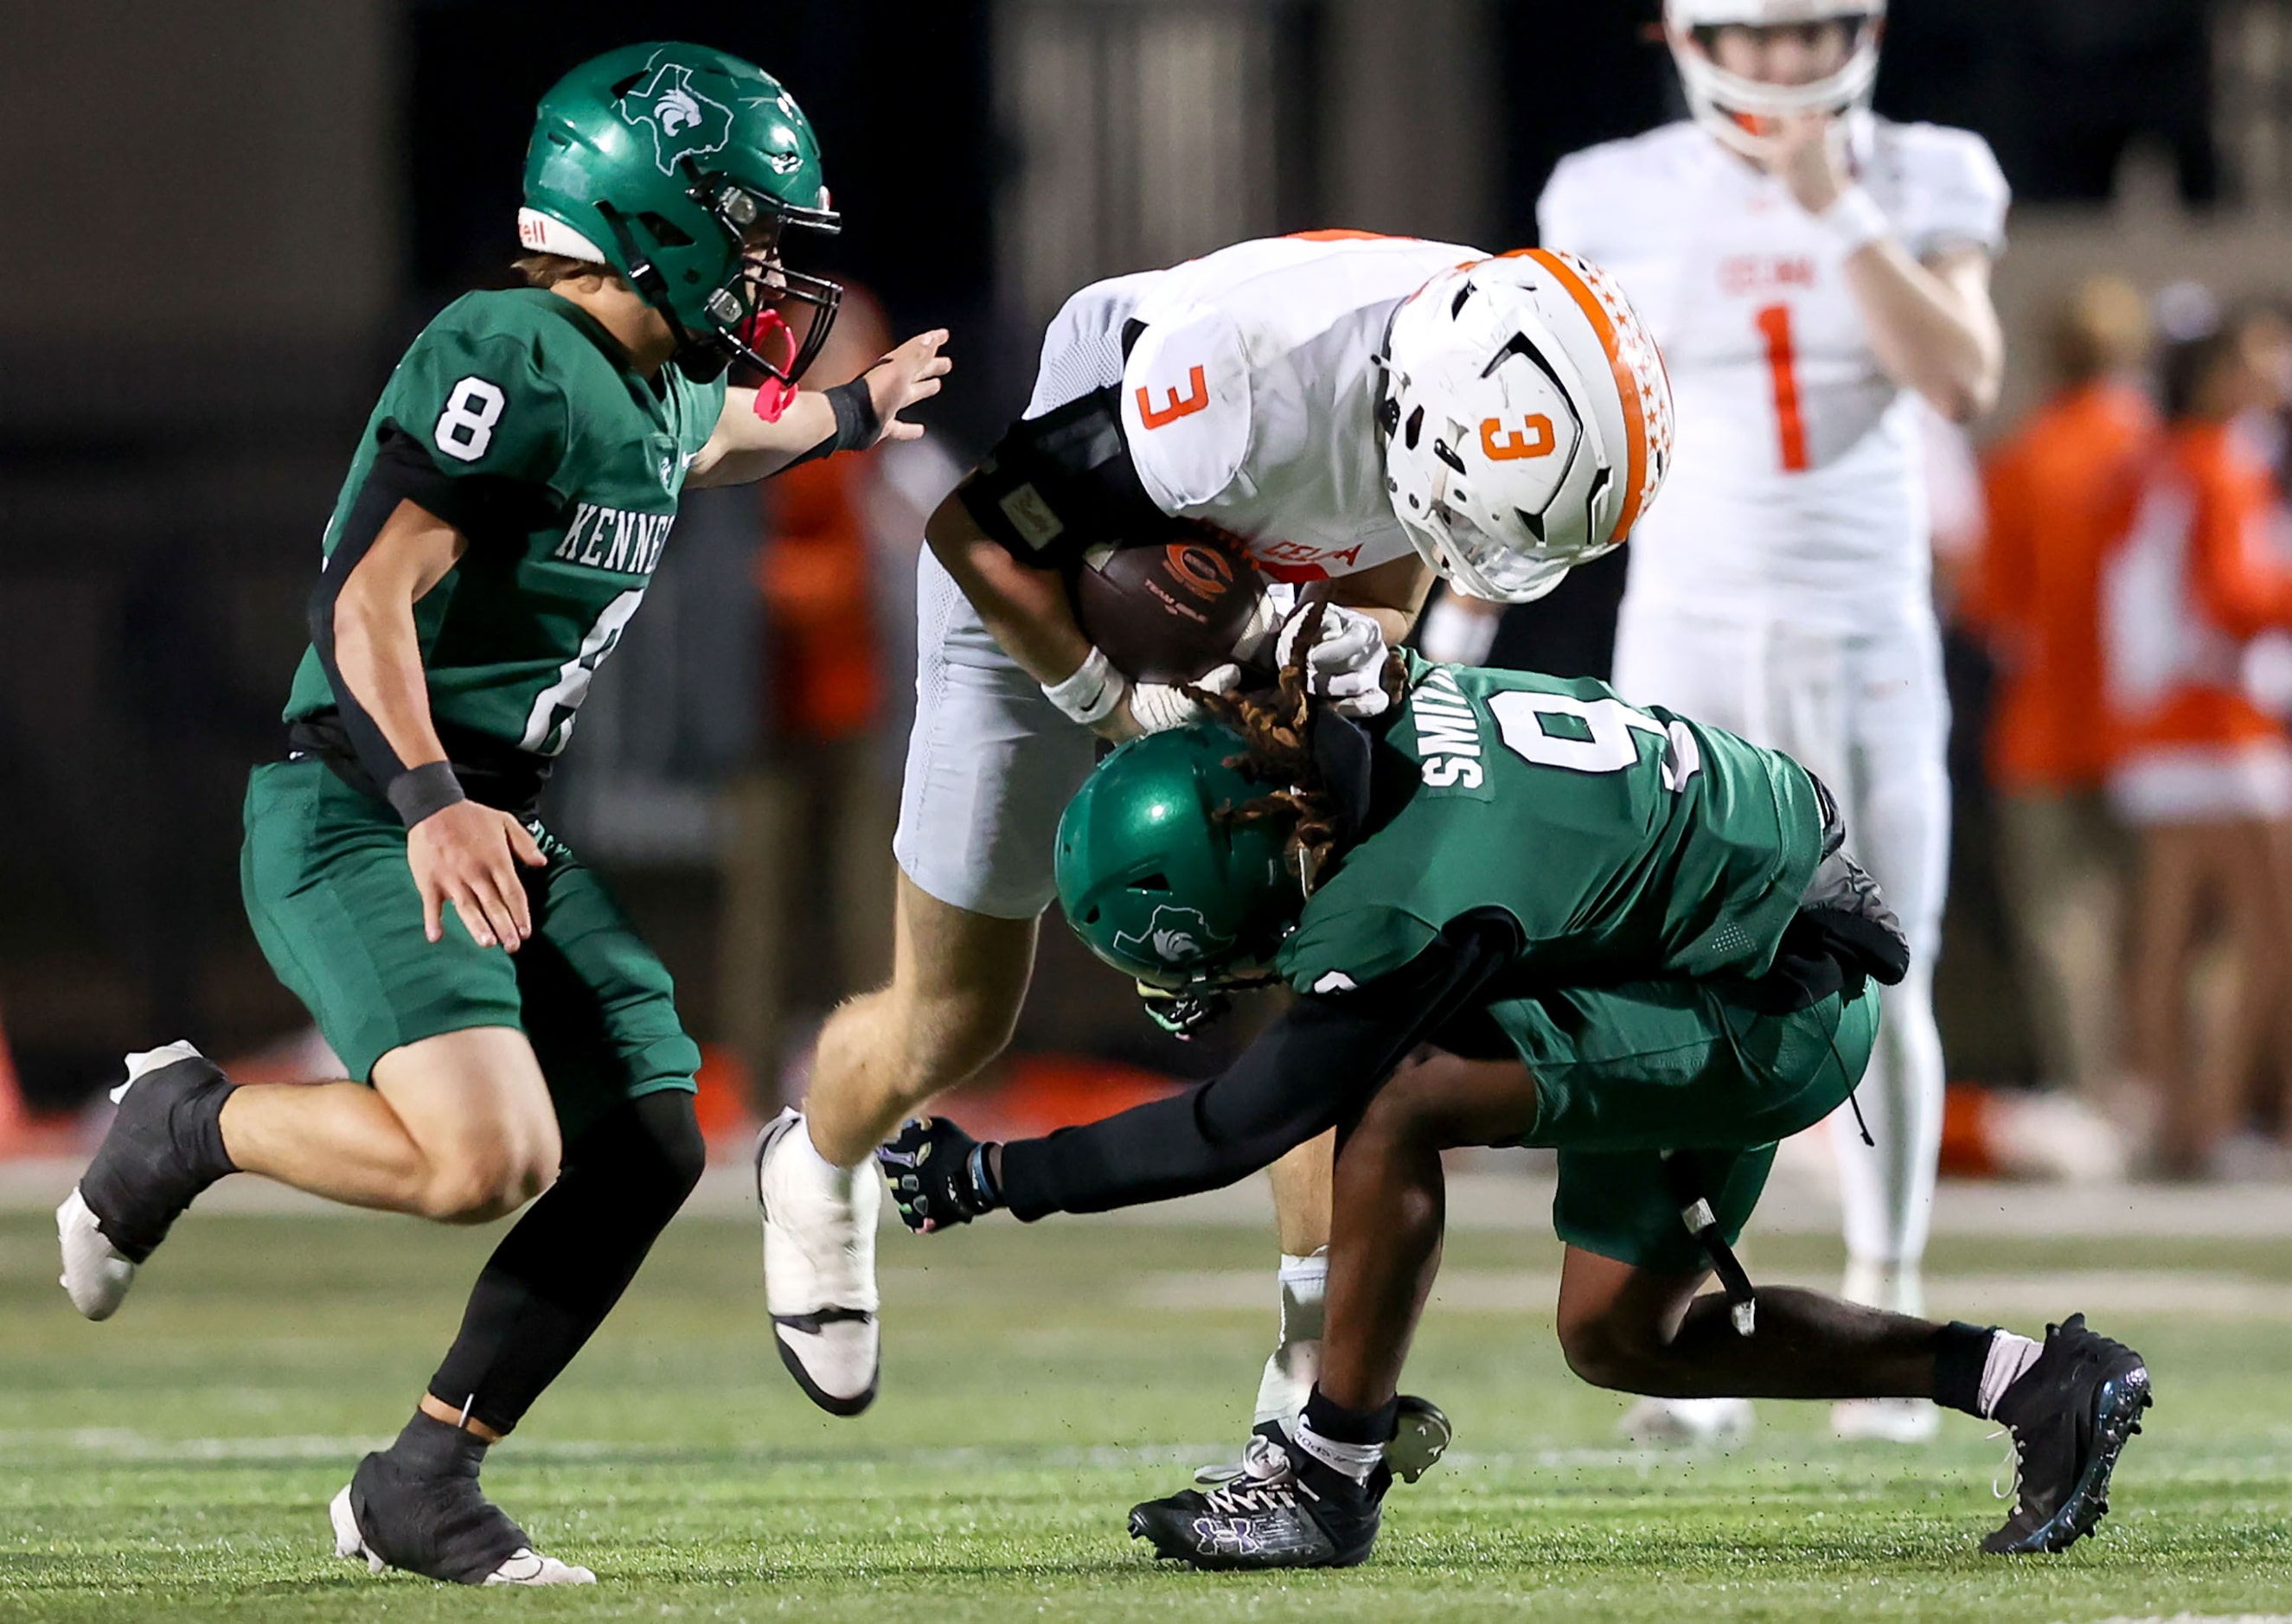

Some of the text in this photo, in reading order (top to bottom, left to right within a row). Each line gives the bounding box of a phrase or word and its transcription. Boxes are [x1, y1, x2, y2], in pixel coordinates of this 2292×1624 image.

[434, 375, 506, 462] 8
[1136, 365, 1209, 431] 3
[1752, 303, 1809, 476] 1
[1480, 413, 1556, 461] 3
[554, 502, 675, 575] KENNE
